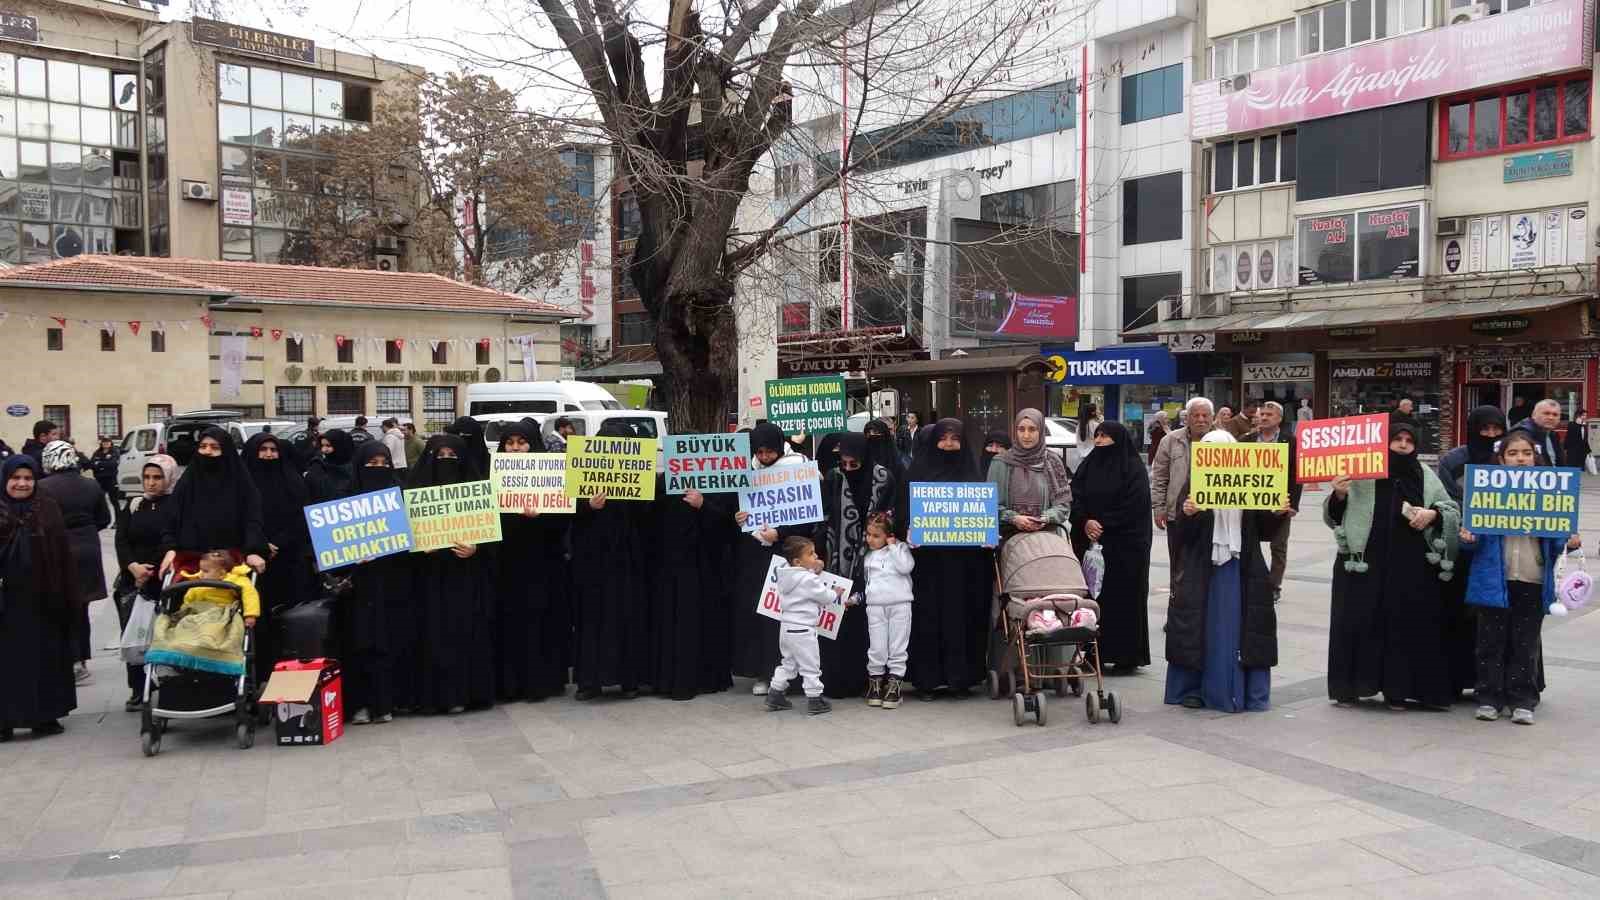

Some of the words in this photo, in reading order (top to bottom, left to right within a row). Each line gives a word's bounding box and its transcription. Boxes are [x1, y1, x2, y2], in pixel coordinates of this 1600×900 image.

[1068, 359, 1145, 376] TURKCELL
[1333, 367, 1376, 377] AMBAR
[769, 383, 807, 397] ÖLÜMDEN
[809, 382, 842, 395] KORKMA
[771, 399, 808, 417] ÇÜNKÜ
[811, 397, 842, 412] ÖLÜM
[772, 419, 806, 431] AZZE'DE
[807, 417, 833, 432] ÇOCUK
[1301, 418, 1383, 449] SESSİZLİK
[584, 438, 641, 455] ZULMÜN
[676, 436, 736, 454] BÜYÜK
[494, 458, 536, 473] ÇOCUKLAR
[538, 458, 567, 471] UYURK
[571, 457, 615, 470] OLDUĞU
[619, 459, 652, 471] YERDE
[668, 456, 747, 475] ŞEYTAN
[1196, 447, 1251, 468] SUSMAK
[1254, 449, 1284, 472] YOK,
[1299, 448, 1384, 478] İHANETTİR
[501, 474, 529, 487] SESSİZ
[531, 476, 565, 489] OLUNUR,
[582, 471, 640, 484] TARAFSIZ
[669, 472, 750, 490] AMERİKA
[1204, 473, 1274, 488] TARAFSIZ
[1473, 469, 1574, 490] BOYKOT
[409, 482, 492, 505] ZALİMDEN
[497, 490, 539, 508] LÜRKEN
[579, 486, 641, 498] KALINMAZ
[747, 484, 813, 510] YAŞASIN
[913, 487, 954, 499] HERKES
[956, 484, 994, 501] BİRŞEY
[1196, 491, 1248, 505] OLMAK
[1252, 492, 1281, 506] YOK
[1470, 489, 1537, 511] AHLAKİ
[1542, 490, 1575, 512] BİR
[309, 491, 401, 528] SUSMAK
[410, 503, 450, 518] MEDET
[746, 505, 818, 527] CEHENNEM
[922, 501, 960, 513] YAPSIN
[963, 502, 986, 513] AMA
[332, 517, 390, 543] ORTAK
[415, 512, 495, 534] ZULÜMDEN
[913, 516, 950, 528] SAKIN
[954, 514, 996, 528] SESSİZ
[1471, 514, 1571, 534] DURUŞTUR
[416, 528, 496, 548] KURTULAMAZ
[923, 531, 986, 543] KALMASIN
[320, 533, 411, 567] OLMAKTIR
